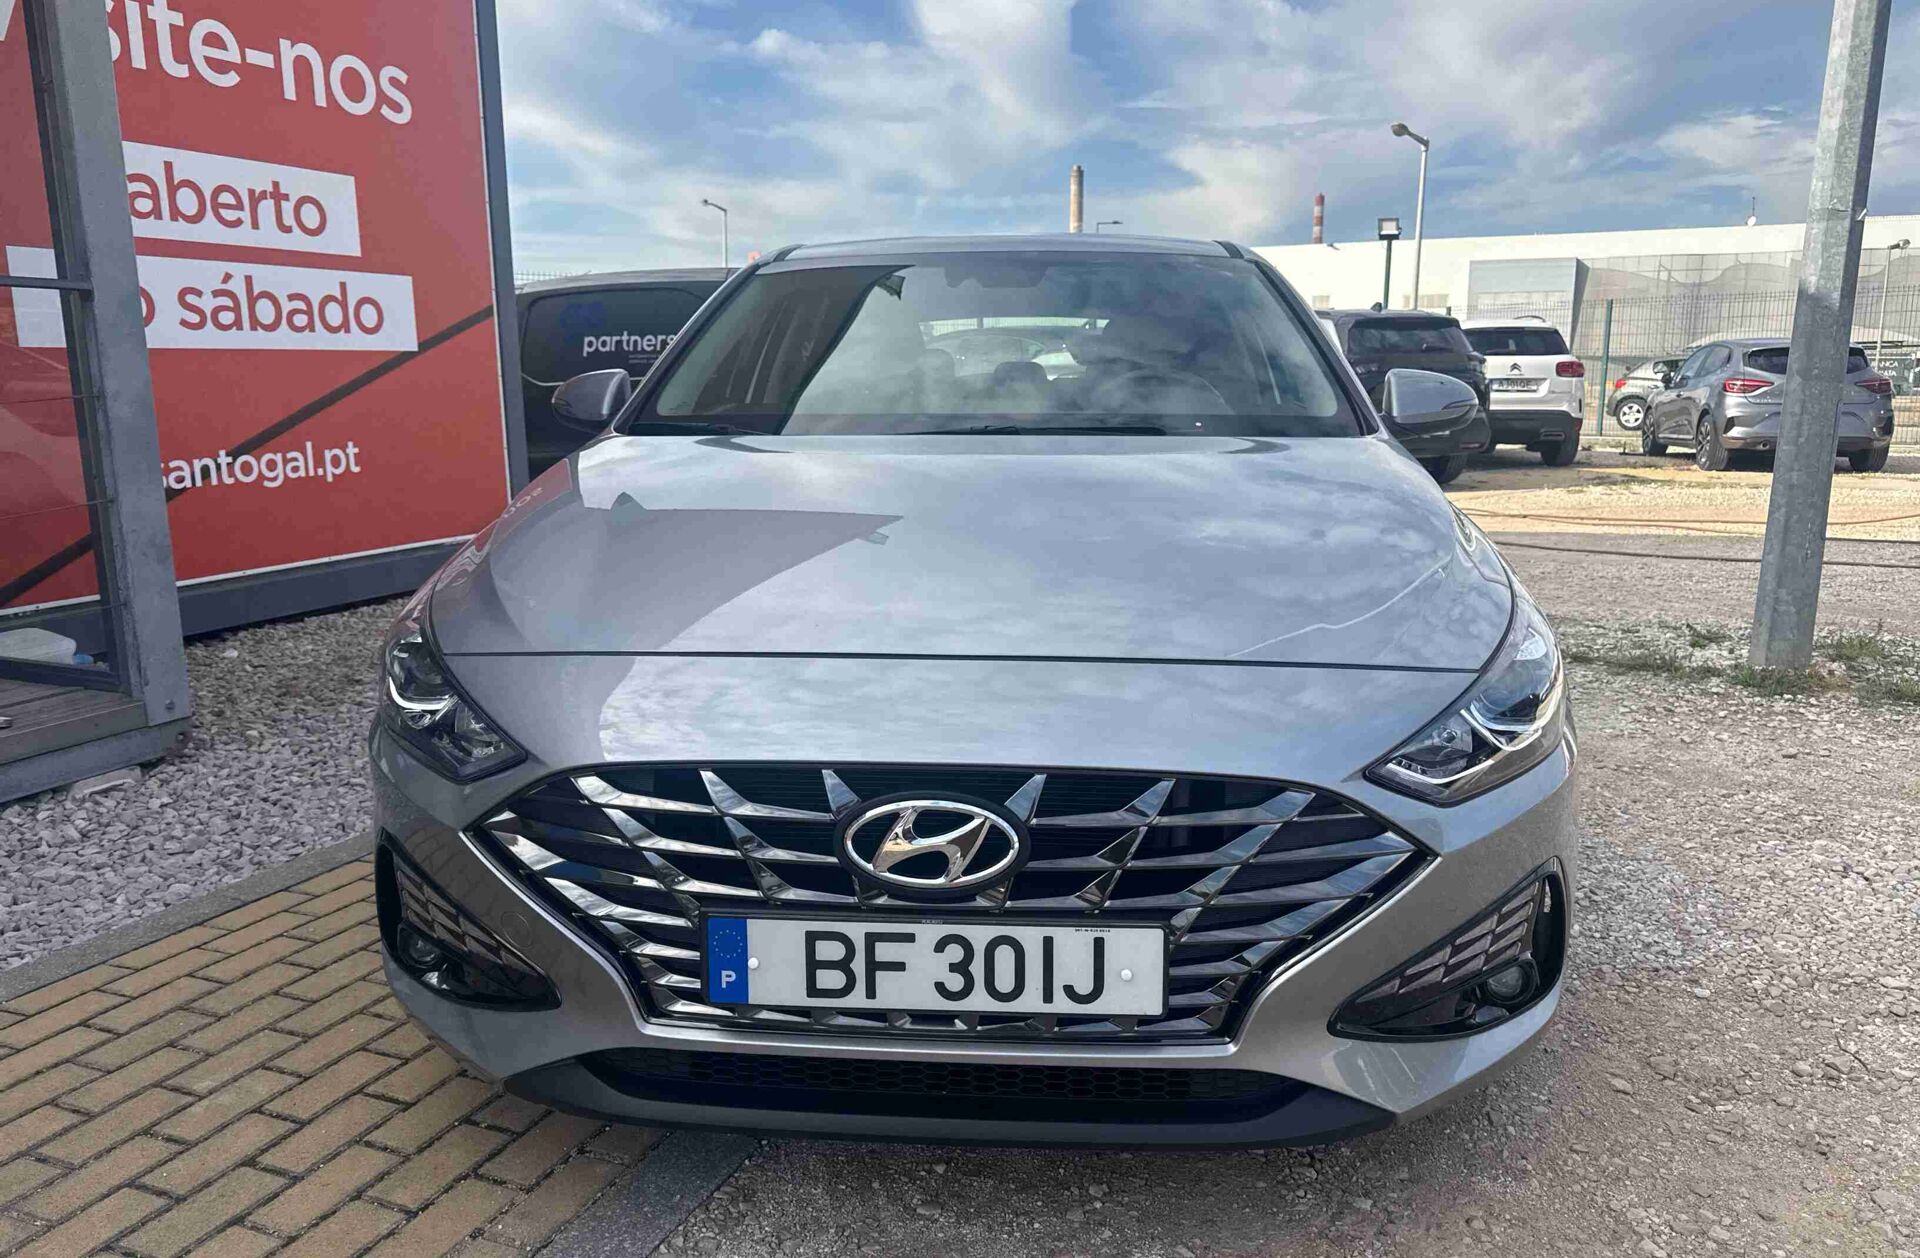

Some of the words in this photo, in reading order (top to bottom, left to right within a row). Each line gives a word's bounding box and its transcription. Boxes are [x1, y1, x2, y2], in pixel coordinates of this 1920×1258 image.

[126, 160, 327, 238] aberto
[178, 272, 385, 335] sábado
[583, 331, 676, 357] partners
[720, 970, 736, 989] P
